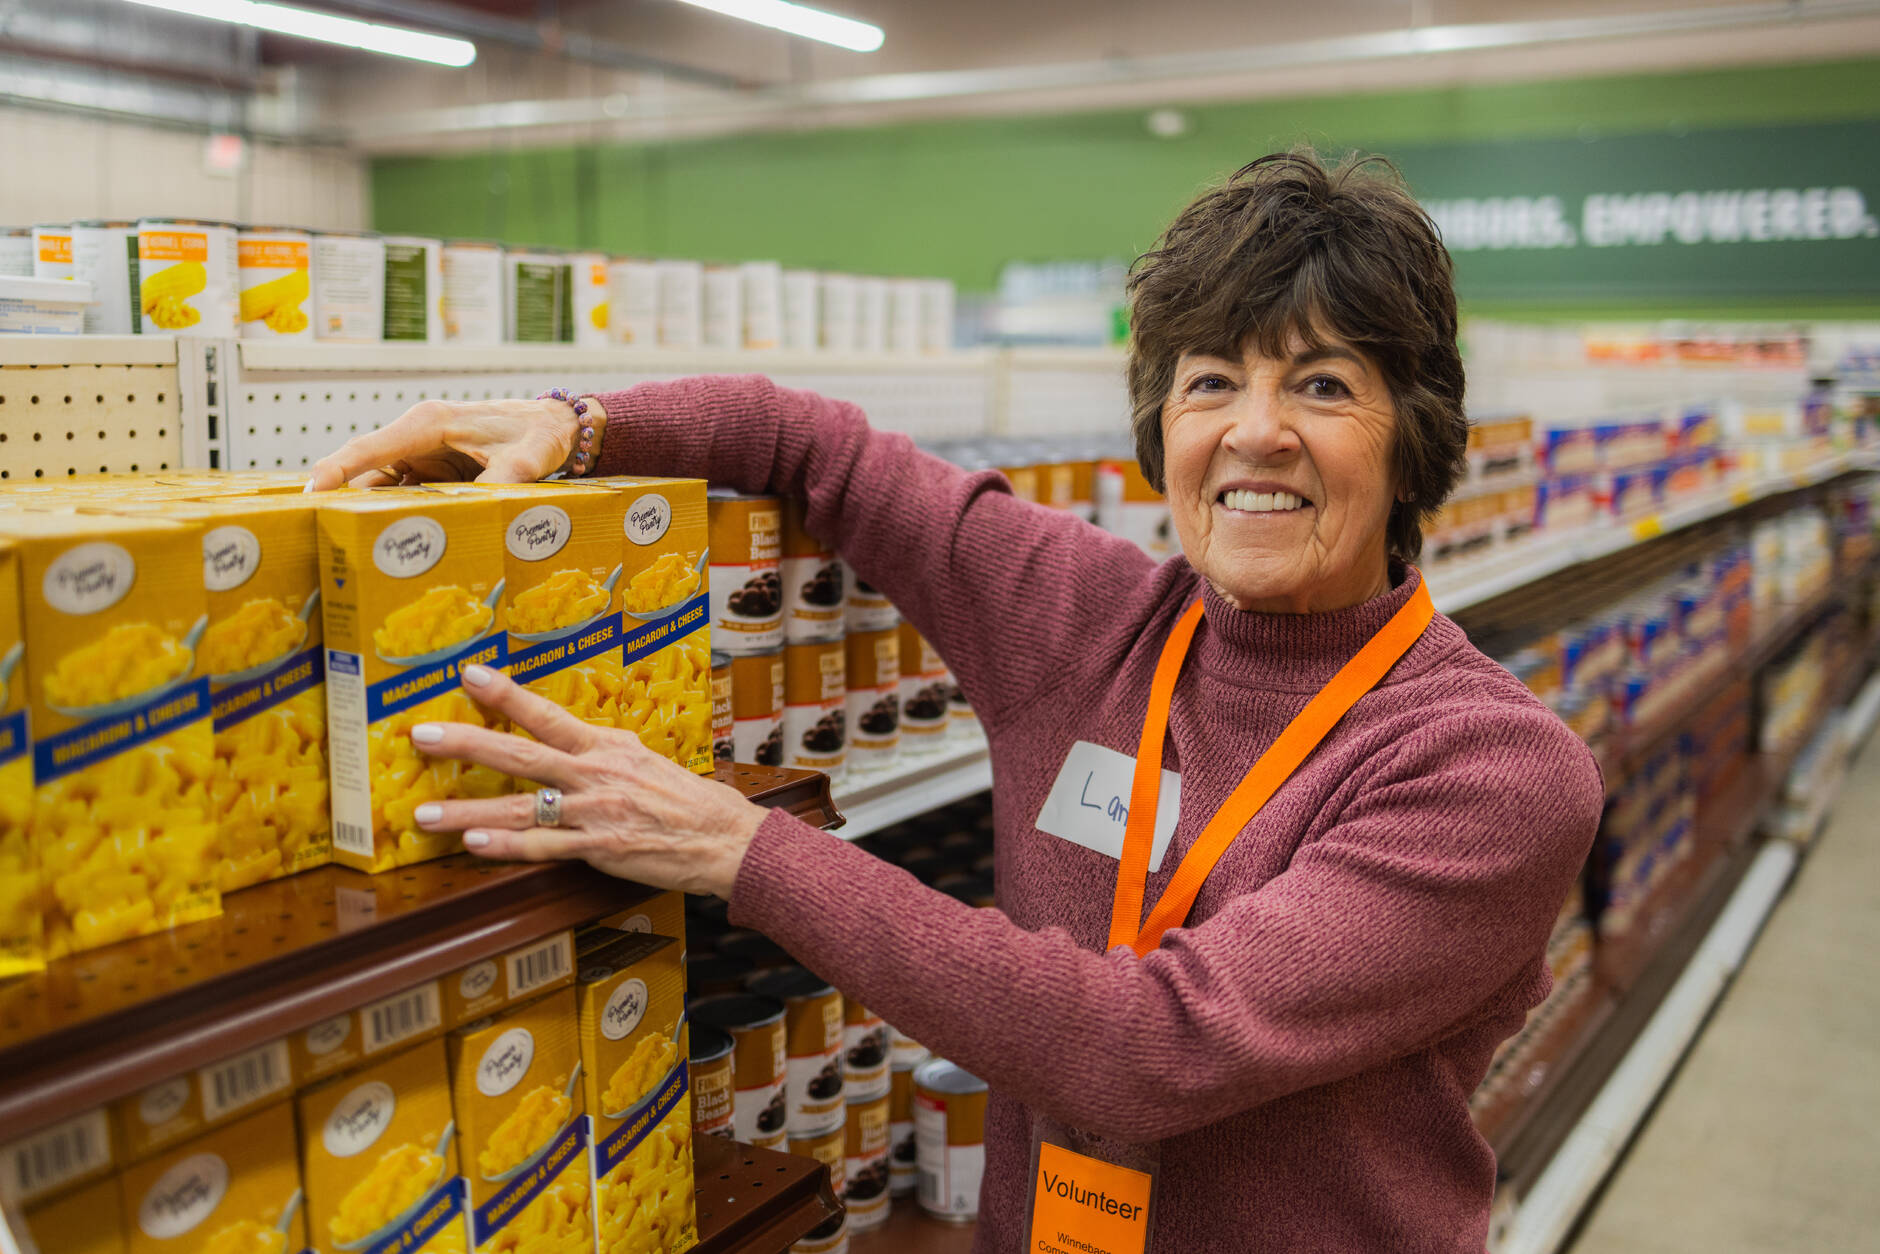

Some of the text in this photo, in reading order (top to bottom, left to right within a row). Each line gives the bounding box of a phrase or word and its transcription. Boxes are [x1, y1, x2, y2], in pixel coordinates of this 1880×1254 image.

[1582, 187, 1879, 248] EMPOWERED.
[515, 518, 550, 541] Premier
[527, 528, 557, 550] Pantry
[631, 506, 657, 527] Premier
[640, 515, 661, 535] Pantry
[509, 626, 614, 676] MACARONI & CHEESE
[627, 624, 669, 654] MACARONI
[670, 620, 677, 633] &
[678, 604, 705, 629] CHEESE
[382, 645, 498, 706] MACARONI & CHEESE
[212, 687, 262, 719] ACARONI
[608, 1076, 681, 1160] MACARONI & CHEESE
[698, 1088, 729, 1108] Black
[487, 1133, 577, 1225] MACARONI & CHEESE
[1043, 1170, 1143, 1221] Volunteer
